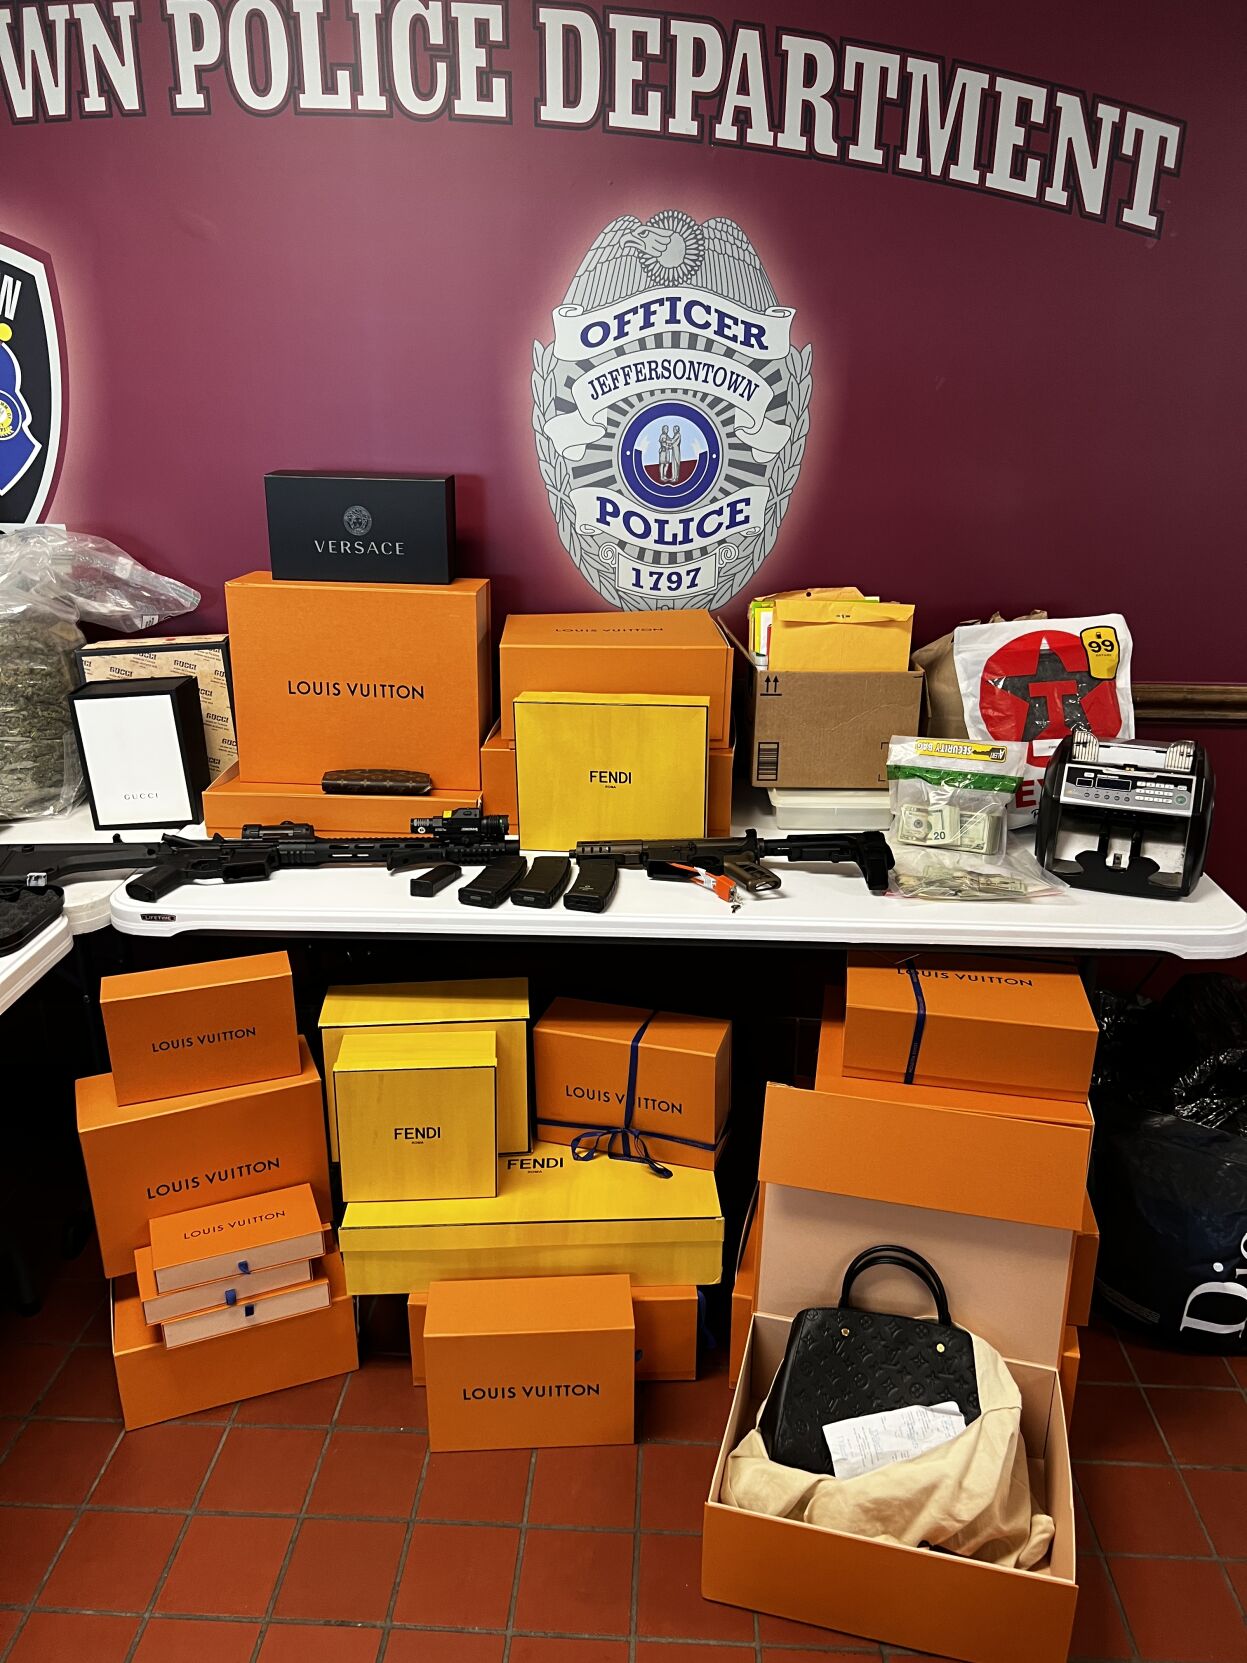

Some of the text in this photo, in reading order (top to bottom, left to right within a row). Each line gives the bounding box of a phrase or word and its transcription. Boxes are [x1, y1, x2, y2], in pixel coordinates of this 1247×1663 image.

[172, 0, 508, 118] POLICE
[539, 7, 1183, 231] DEPARTMENT
[580, 296, 769, 351] OFFICER
[587, 359, 760, 402] JEFFERSONTOWN
[596, 496, 751, 546] POLICE
[314, 540, 405, 555] VERSACE
[631, 567, 702, 592] 1797
[1088, 639, 1114, 653] 99
[288, 680, 424, 699] LOUIS VUITTON
[935, 742, 972, 755] SECURITY
[590, 771, 632, 784] FENDI
[124, 792, 159, 800] GUCCI
[933, 831, 946, 840] 20
[955, 973, 1033, 987] VUITTON
[152, 1027, 256, 1053] LOUIS VUITTON
[565, 1085, 682, 1114] LOUIS VITTON
[394, 1126, 441, 1140] FENDI
[507, 1157, 564, 1170] FENDI
[147, 1157, 280, 1199] LOUIS VUITTON
[184, 1210, 286, 1239] LOUIS VUITTON
[463, 1384, 600, 1400] LOUIS VUITTON
